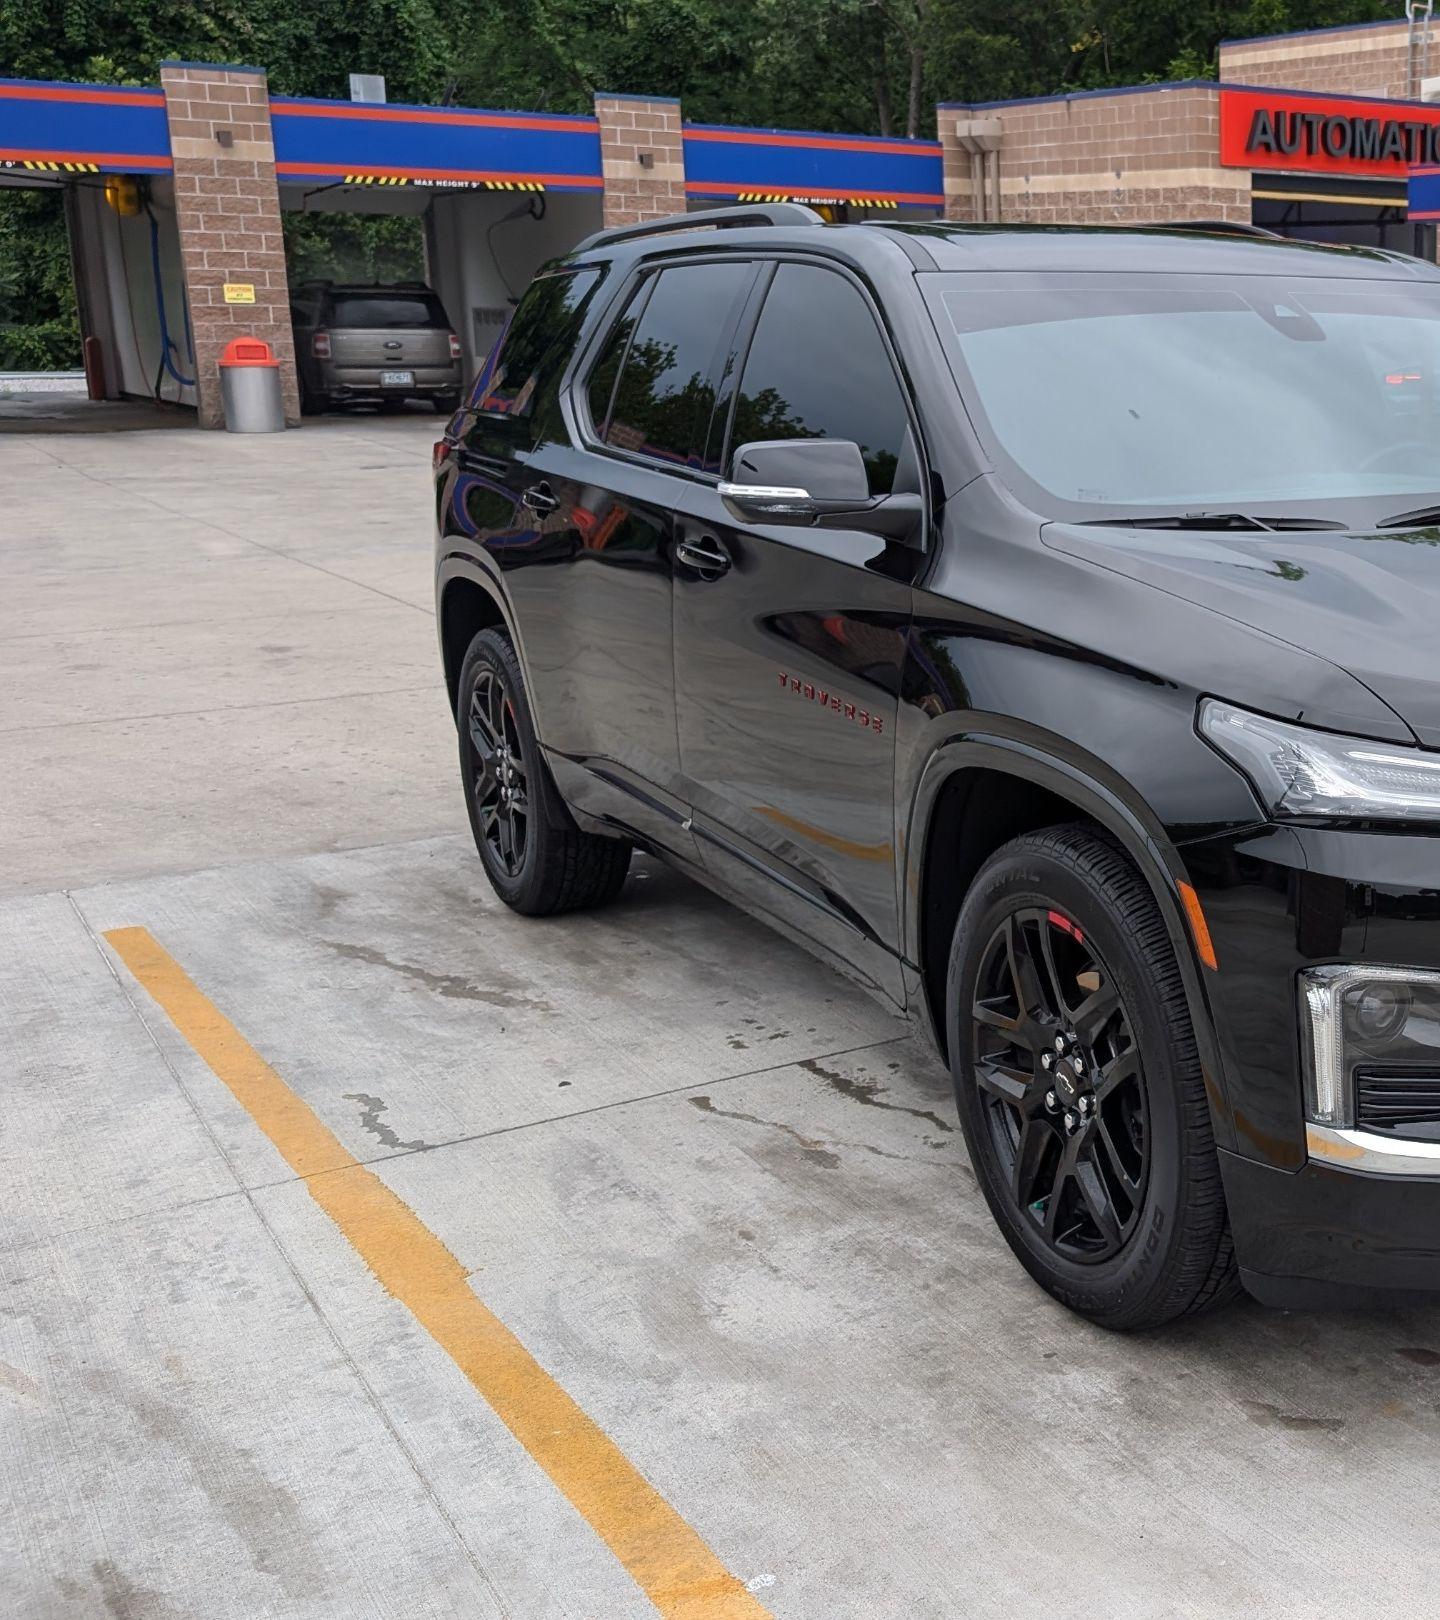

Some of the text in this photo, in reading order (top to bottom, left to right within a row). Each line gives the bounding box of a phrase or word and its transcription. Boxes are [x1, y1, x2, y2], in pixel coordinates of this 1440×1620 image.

[413, 179, 434, 187] MAX
[436, 180, 470, 188] HEIGHT
[778, 672, 883, 734] TRAVERSE
